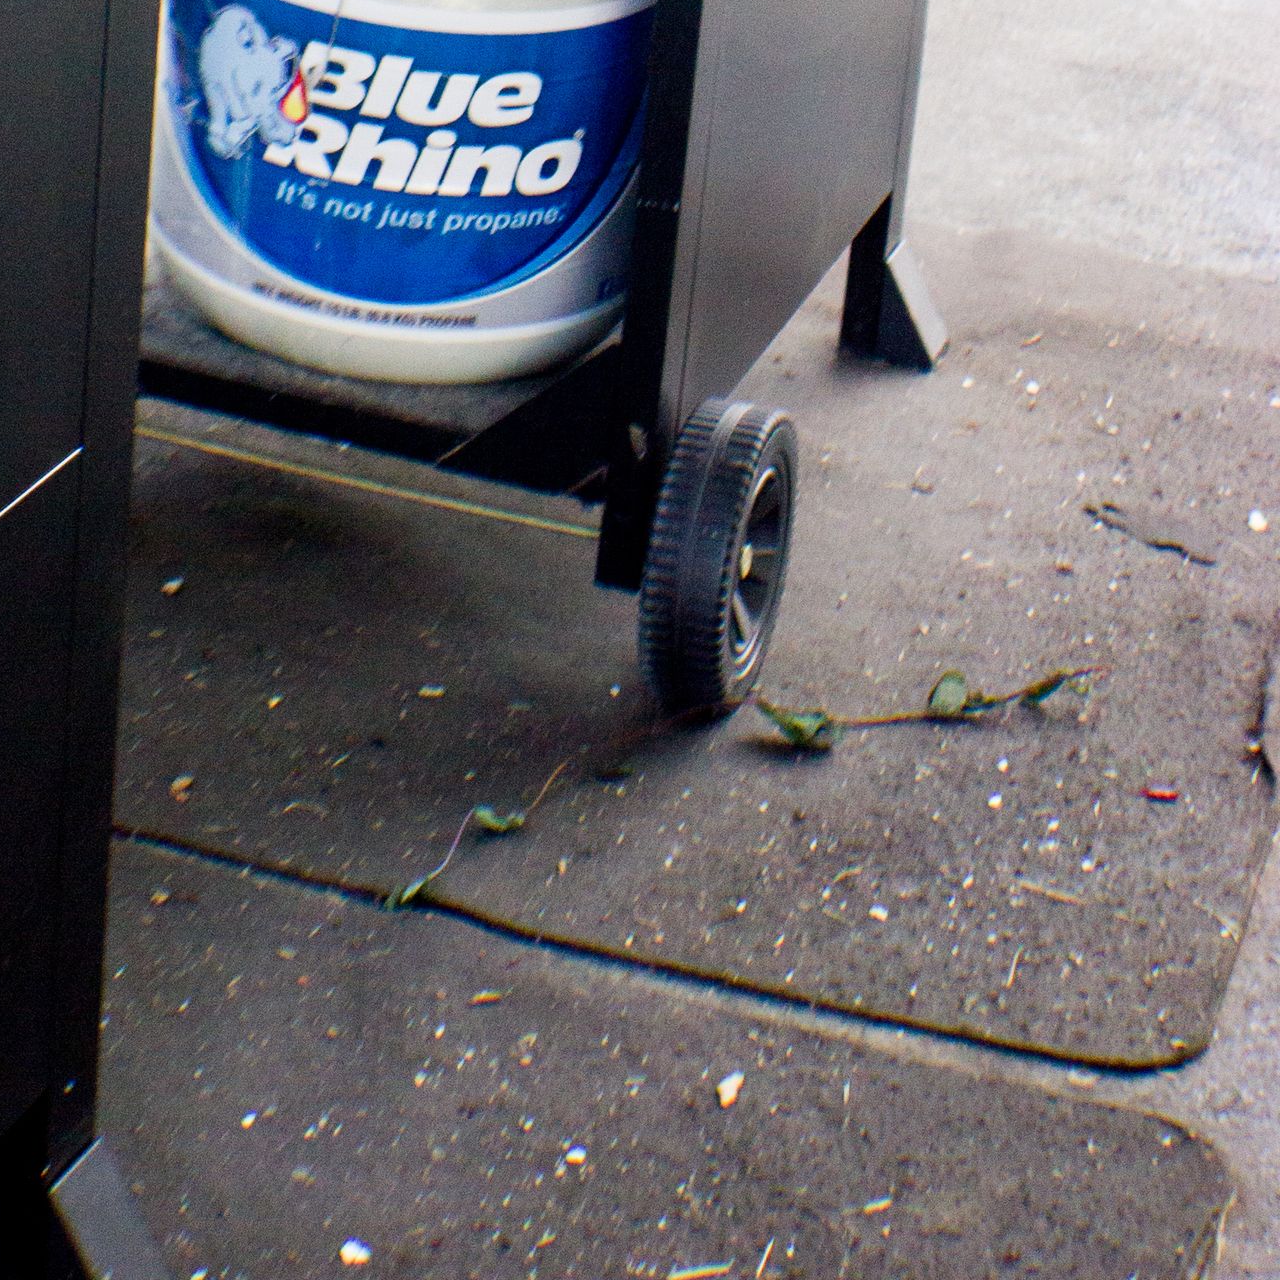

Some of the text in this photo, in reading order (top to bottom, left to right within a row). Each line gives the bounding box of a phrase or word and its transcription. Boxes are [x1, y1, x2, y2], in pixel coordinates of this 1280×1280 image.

[298, 40, 543, 128] Blue
[262, 111, 584, 198] Rhino
[275, 180, 318, 211] It's
[323, 197, 374, 223] not
[375, 203, 438, 231] just
